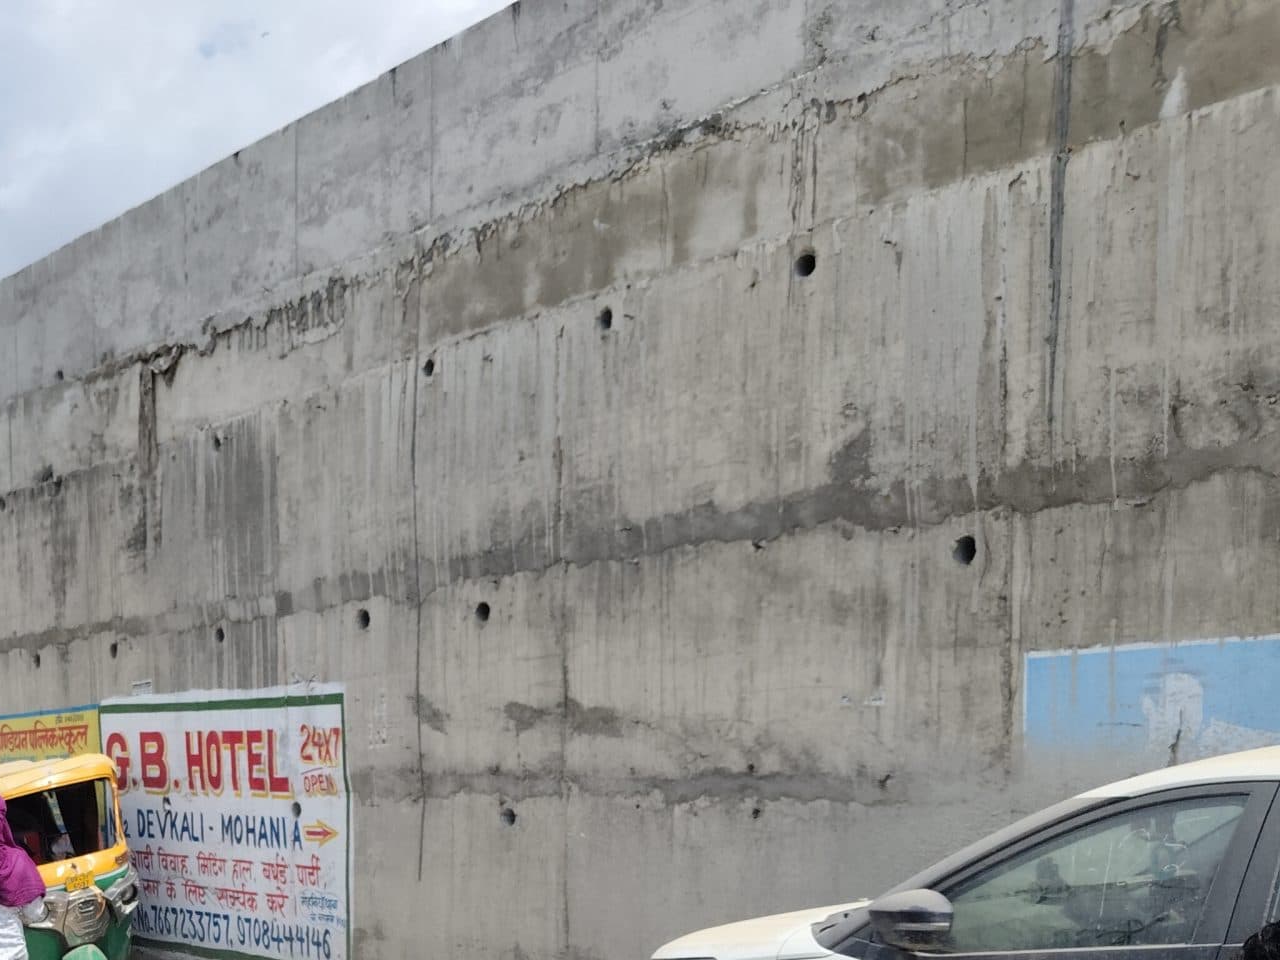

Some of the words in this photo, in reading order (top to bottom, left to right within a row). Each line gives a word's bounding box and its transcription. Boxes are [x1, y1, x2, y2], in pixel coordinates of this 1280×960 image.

[185, 729, 292, 797] HOTEL
[303, 773, 336, 795] OPEN
[137, 808, 204, 842] DEVKALI
[221, 813, 304, 851] MOHANIA
[237, 915, 331, 960] 9708444146
